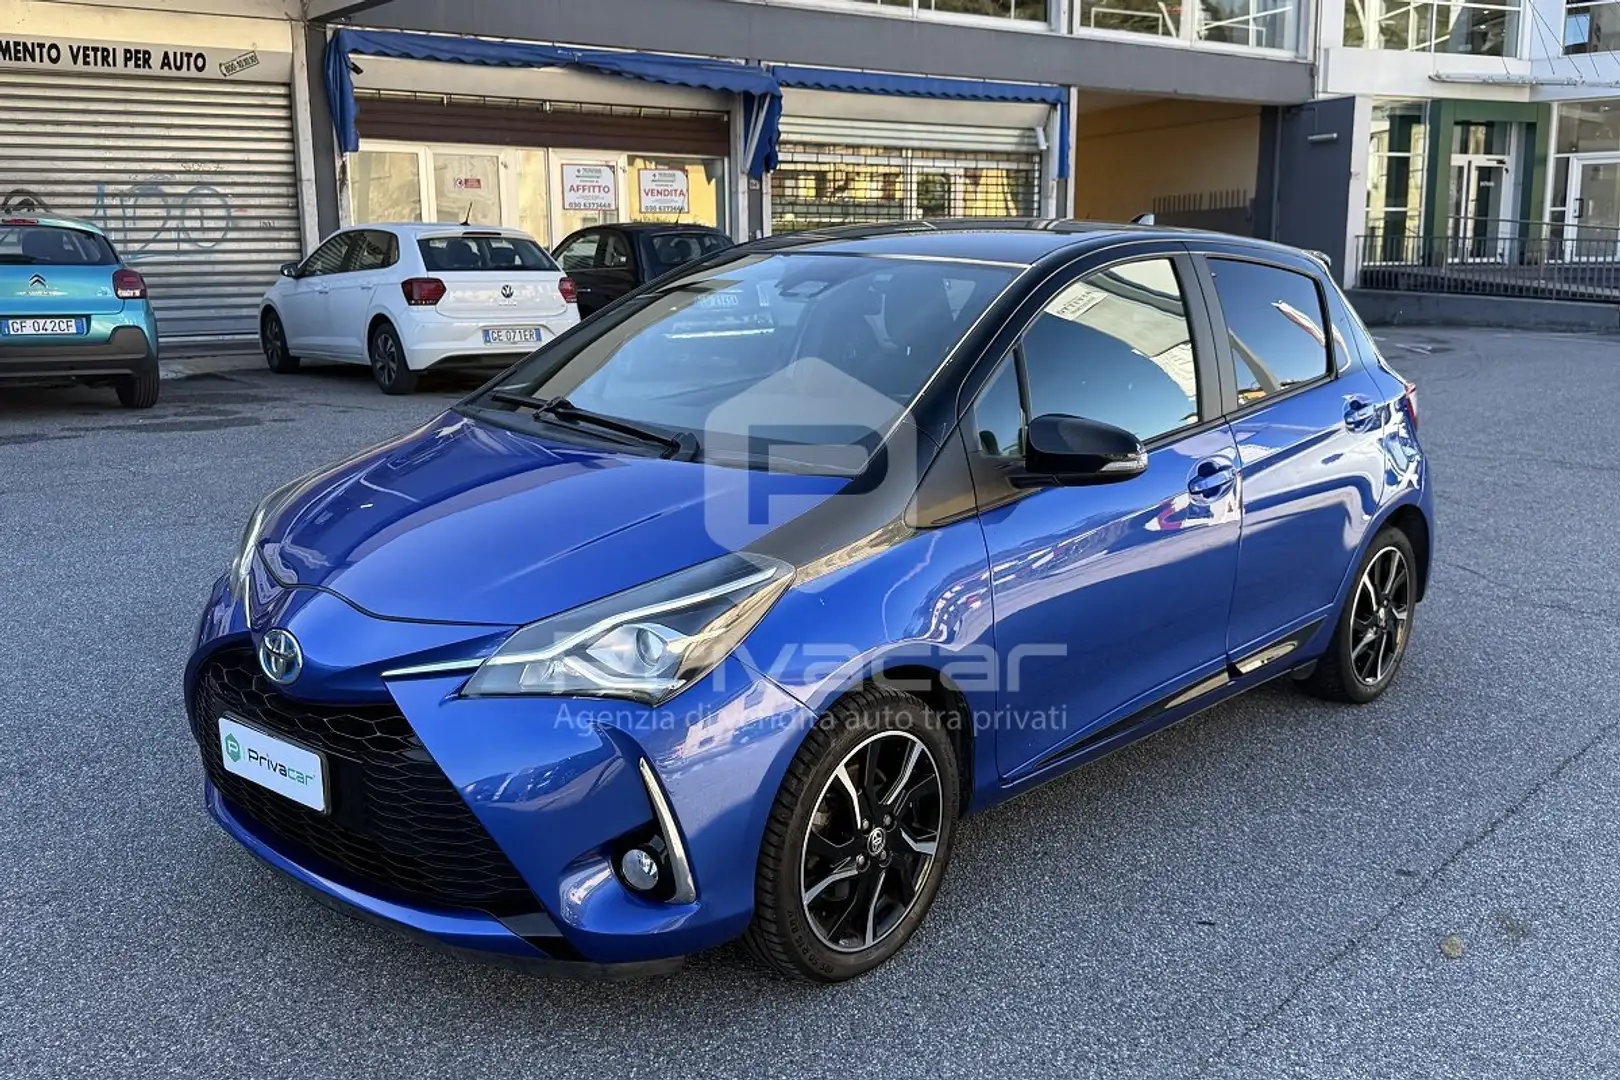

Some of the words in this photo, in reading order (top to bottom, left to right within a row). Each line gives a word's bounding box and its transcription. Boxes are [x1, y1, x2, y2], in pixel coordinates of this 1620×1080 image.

[0, 40, 61, 64] MENTO
[68, 44, 118, 68] VETRI
[123, 48, 152, 69] PER
[160, 50, 207, 72] AUTO
[568, 184, 611, 194] AFFITTO
[643, 188, 686, 198] VENDITA
[247, 748, 314, 786] Privacar
